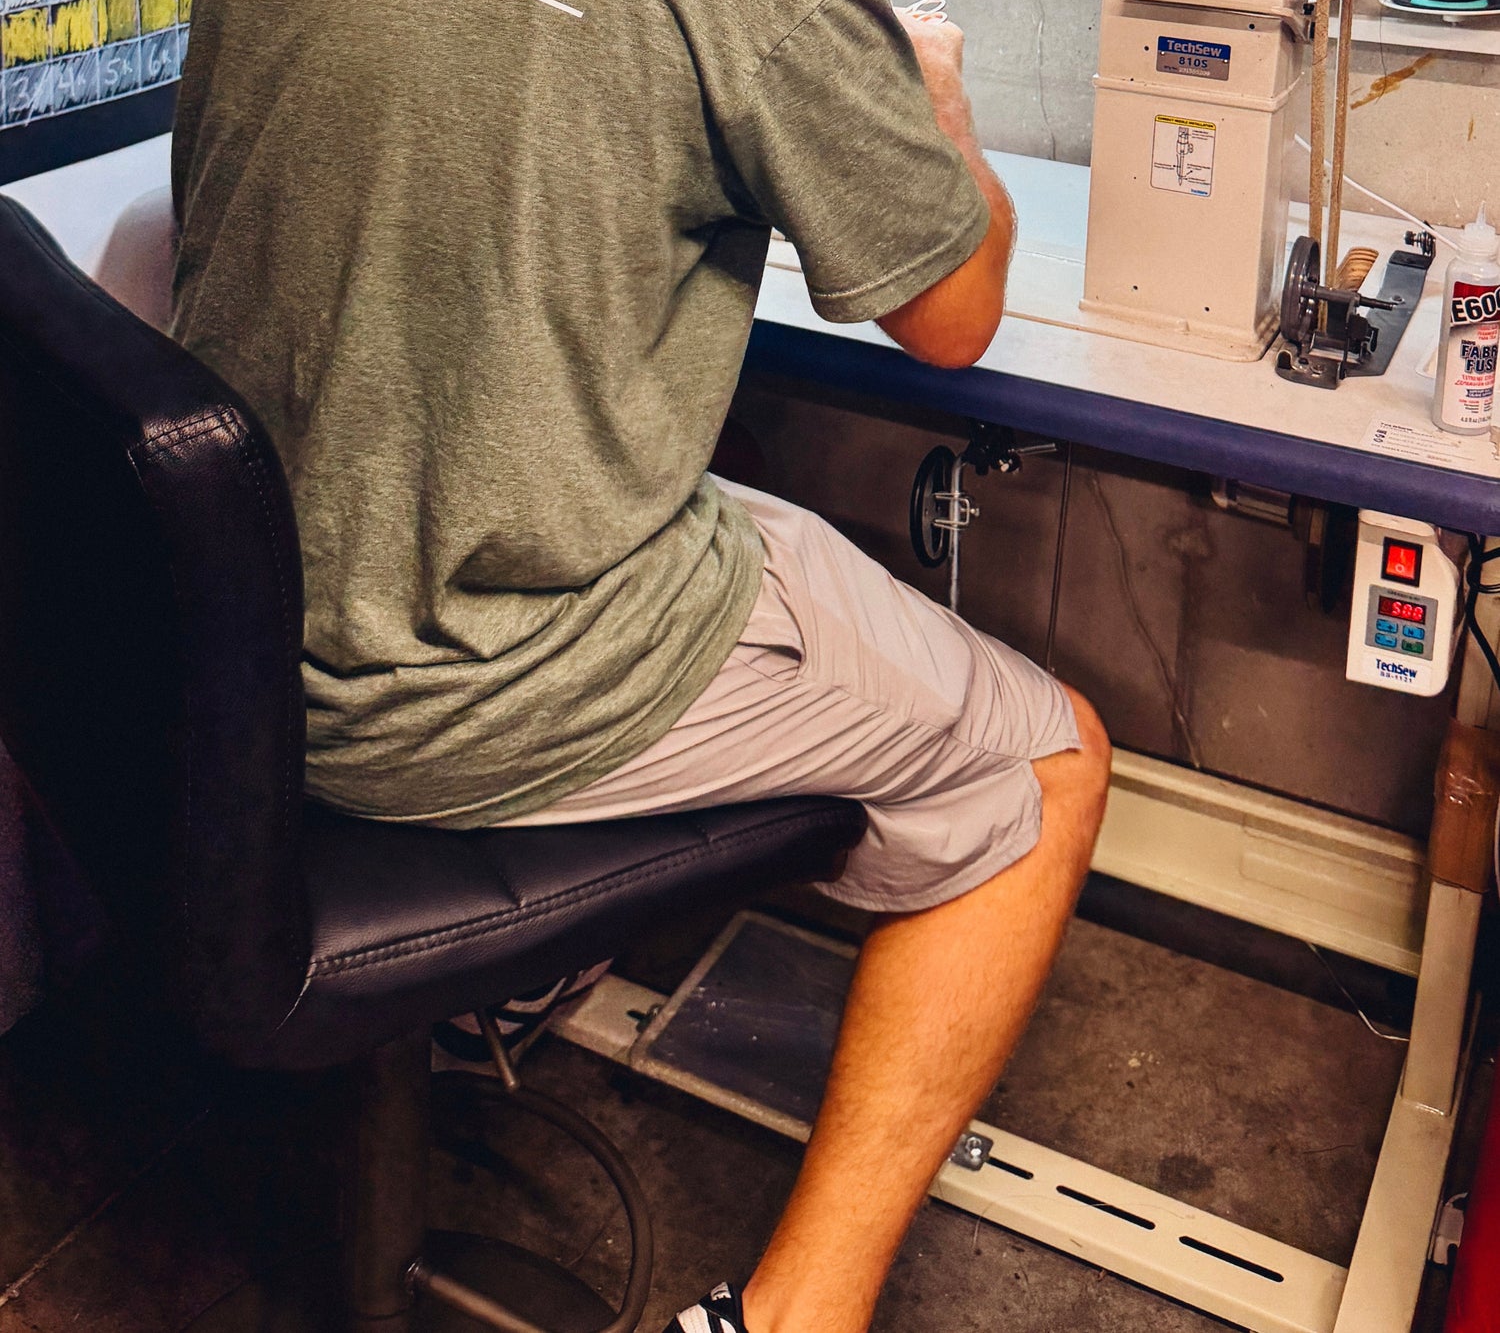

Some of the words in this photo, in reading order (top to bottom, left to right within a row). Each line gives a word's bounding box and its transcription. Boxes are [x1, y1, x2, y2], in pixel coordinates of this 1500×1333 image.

[1167, 39, 1222, 57] TechSew
[1178, 56, 1208, 68] 810S
[1452, 286, 1500, 323] E60
[1376, 658, 1418, 678] TechSew
